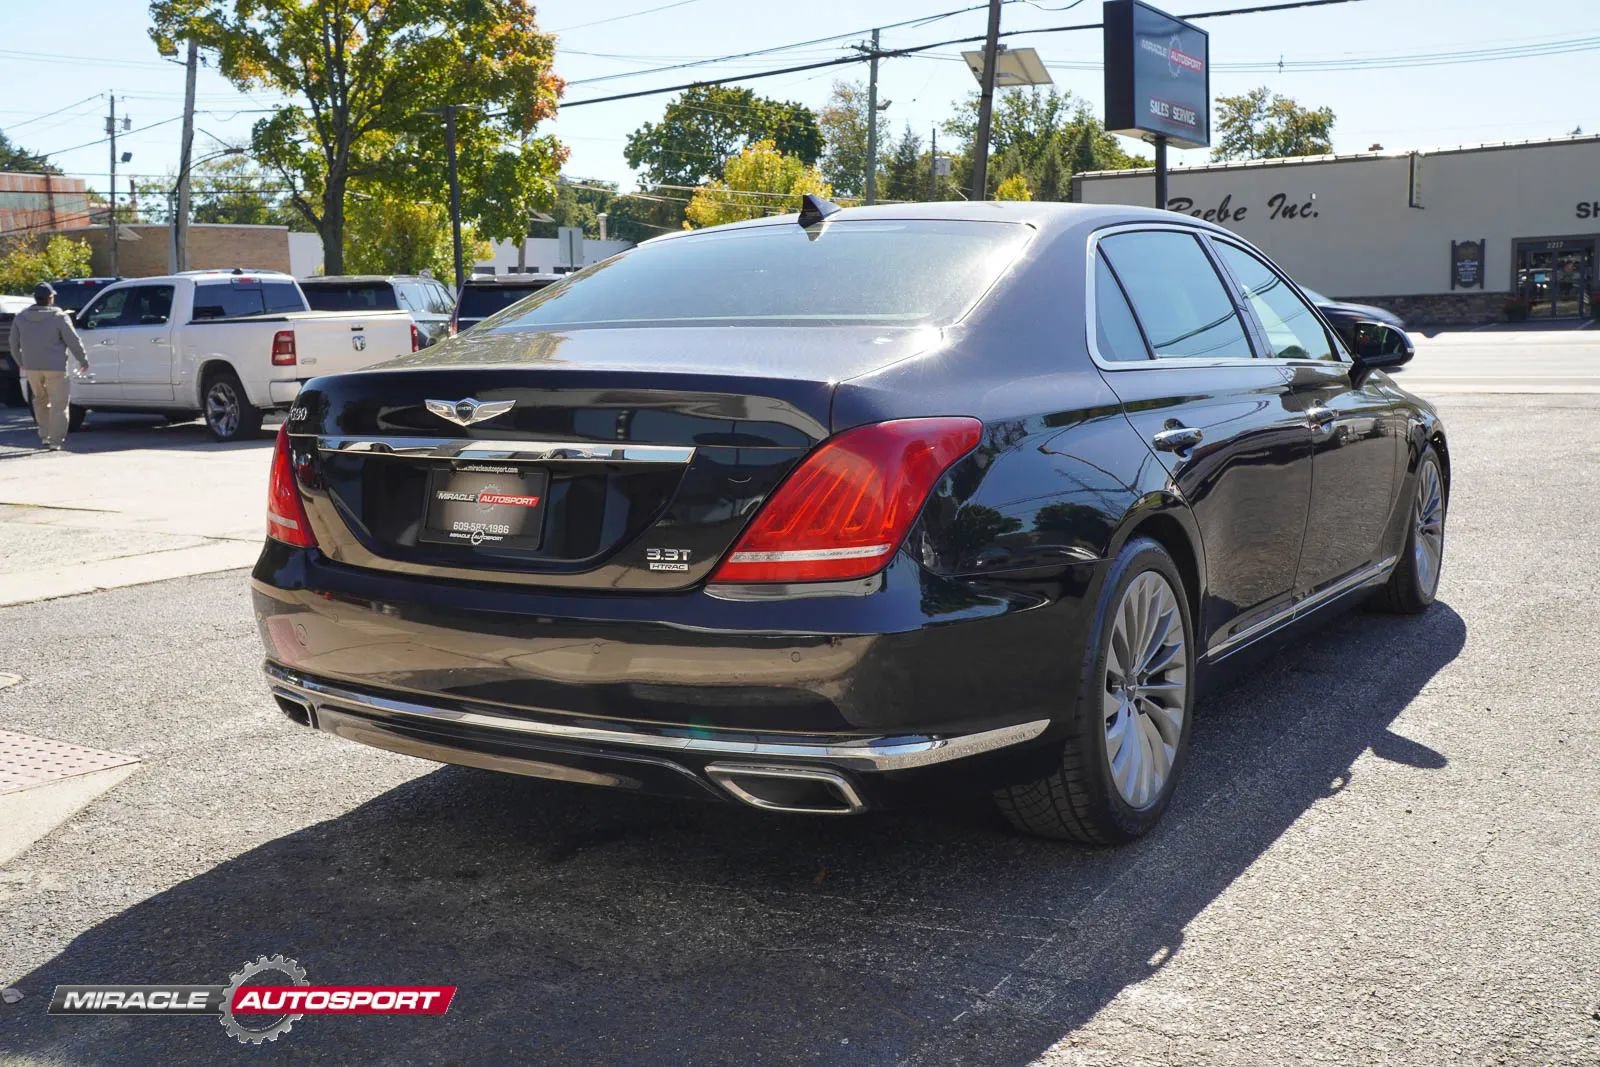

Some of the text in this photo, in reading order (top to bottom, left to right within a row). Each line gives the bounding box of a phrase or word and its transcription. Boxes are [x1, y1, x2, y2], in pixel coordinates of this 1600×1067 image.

[1170, 49, 1202, 70] AUTOSPORT
[1150, 99, 1196, 125] SALES SERVICE
[1267, 192, 1319, 220] Inc.
[437, 491, 536, 505] MIRACLE AUTOSPORT
[453, 521, 510, 534] 609-587-1986
[646, 548, 691, 561] 3.3T
[651, 563, 687, 571] HTRAC
